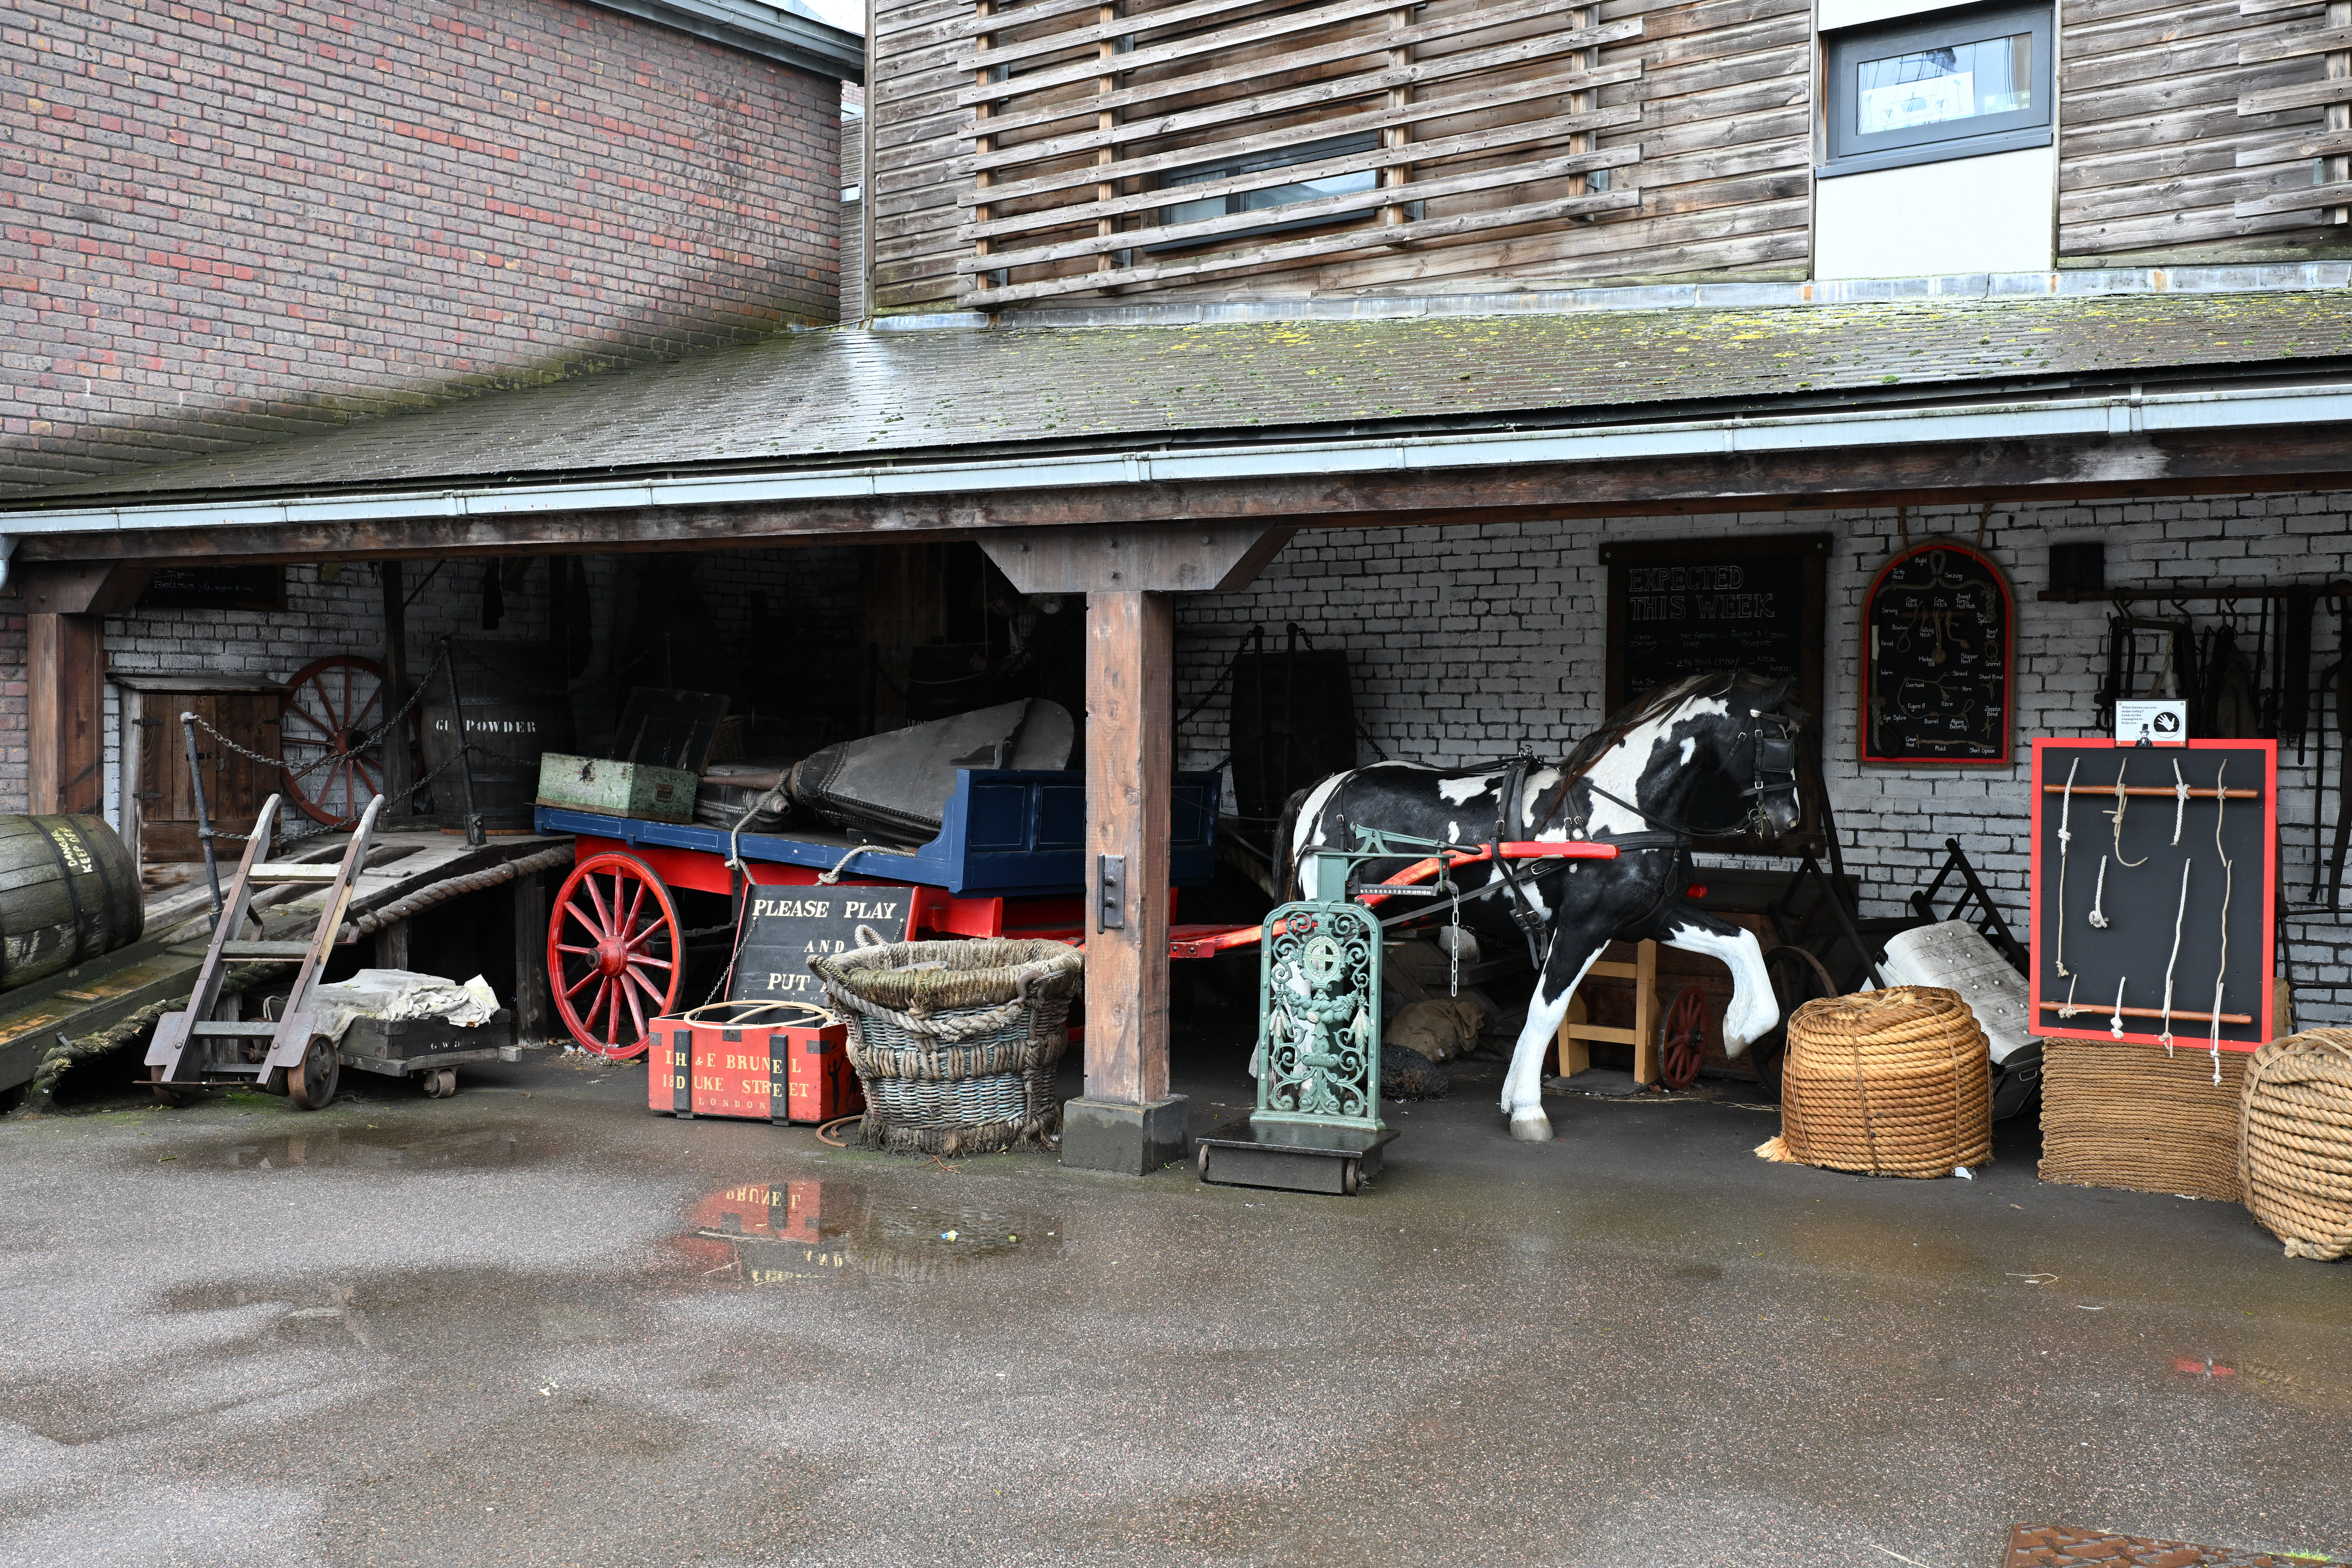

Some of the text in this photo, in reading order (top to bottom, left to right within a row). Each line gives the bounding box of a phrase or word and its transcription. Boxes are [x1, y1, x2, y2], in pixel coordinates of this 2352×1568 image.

[1915, 557, 1927, 566] Bight
[1629, 565, 1744, 592] EXPECTED
[1945, 572, 1963, 581] Seizing
[154, 579, 194, 589] Bellows
[1630, 593, 1775, 620] THIS WEEK
[1882, 607, 1898, 615] Serving
[1960, 653, 1978, 662] Stopper
[1907, 703, 1921, 712] Figure
[436, 719, 536, 733] GUPOWDER
[51, 829, 78, 867] DANGER
[73, 845, 93, 873] KEEP
[752, 899, 897, 919] PLEASE PLAY
[804, 940, 845, 953] AND
[1310, 969, 1334, 978] BRISTOL
[767, 973, 811, 991] PUT
[695, 1056, 704, 1065] &
[706, 1053, 716, 1067] F.
[726, 1054, 801, 1074] BRUNEL
[676, 1076, 724, 1091] DUKE
[742, 1080, 809, 1098] STREET
[698, 1097, 765, 1109] LONDON
